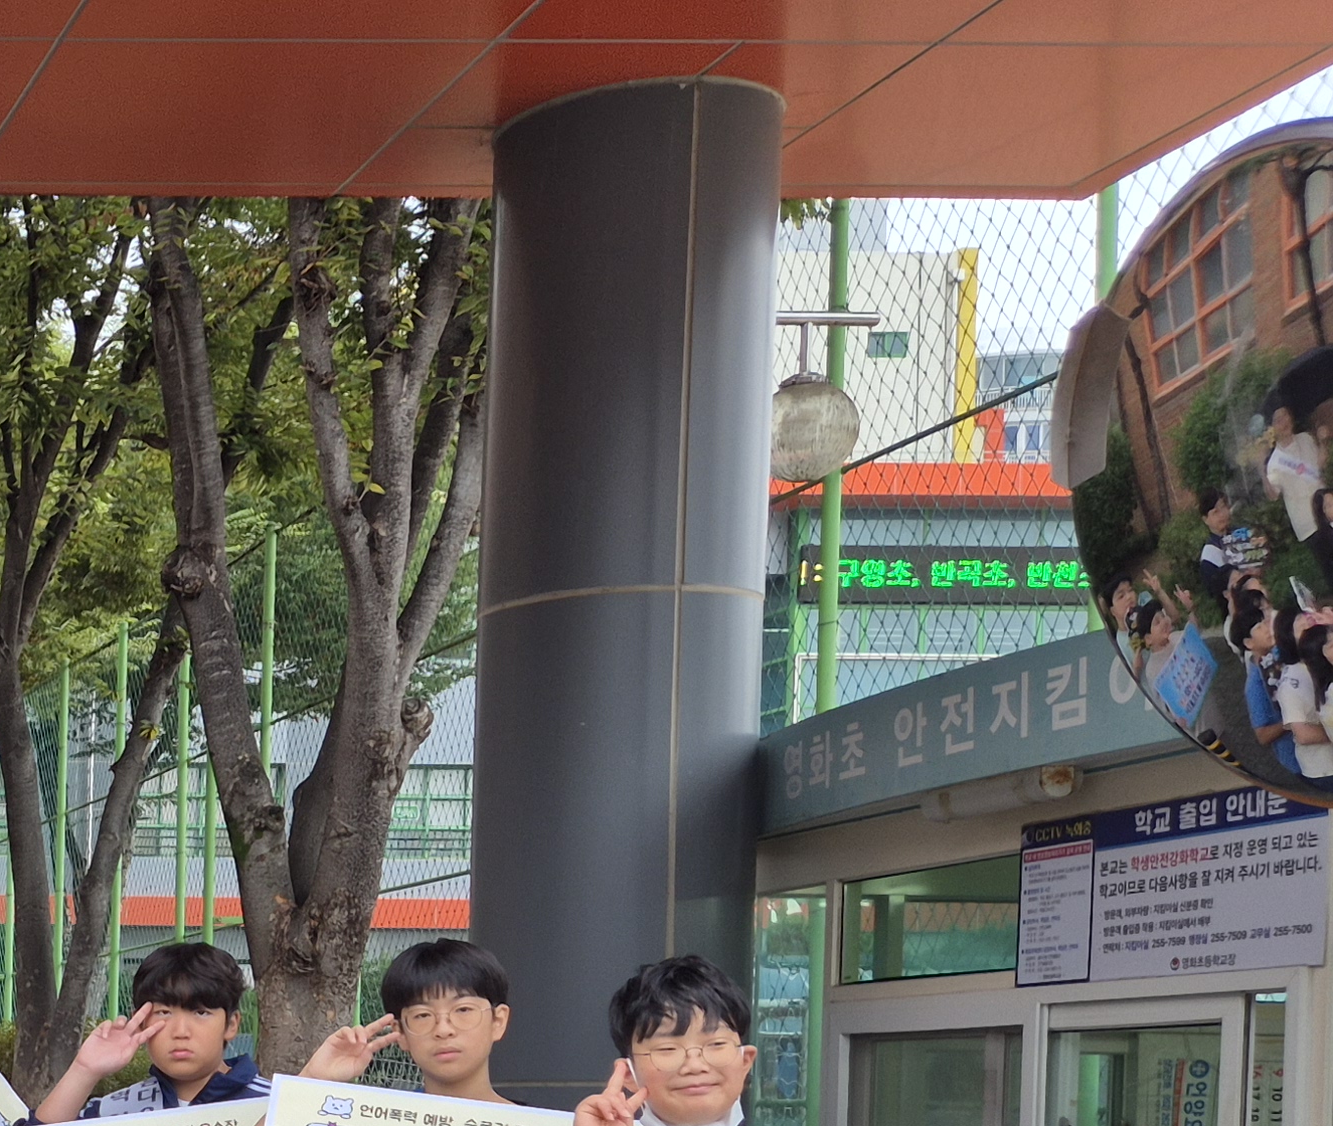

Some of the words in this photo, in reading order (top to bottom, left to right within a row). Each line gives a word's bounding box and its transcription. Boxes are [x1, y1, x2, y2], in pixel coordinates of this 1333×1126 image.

[784, 722, 866, 799] 영화초
[1135, 805, 1171, 836] 학교
[1179, 799, 1217, 830] 출입
[1036, 825, 1063, 842] CCTV
[1100, 854, 1128, 878] 본교는
[1130, 842, 1219, 873] 학생안전강화학교로
[1222, 839, 1243, 859] 지정
[1246, 837, 1268, 856] 운영
[1271, 834, 1293, 852] 되고
[1297, 830, 1320, 848] 있는
[1099, 878, 1146, 900] 학교이므로
[1148, 871, 1198, 893] 다음사항을
[1201, 870, 1211, 887] 잘
[1214, 865, 1235, 884] 지켜
[1238, 863, 1271, 881] 주시기
[1272, 855, 1323, 877] 바랍니다.
[1272, 1086, 1283, 1102] 10
[360, 1103, 418, 1125] 언어폭력
[1270, 1108, 1282, 1124] 11
